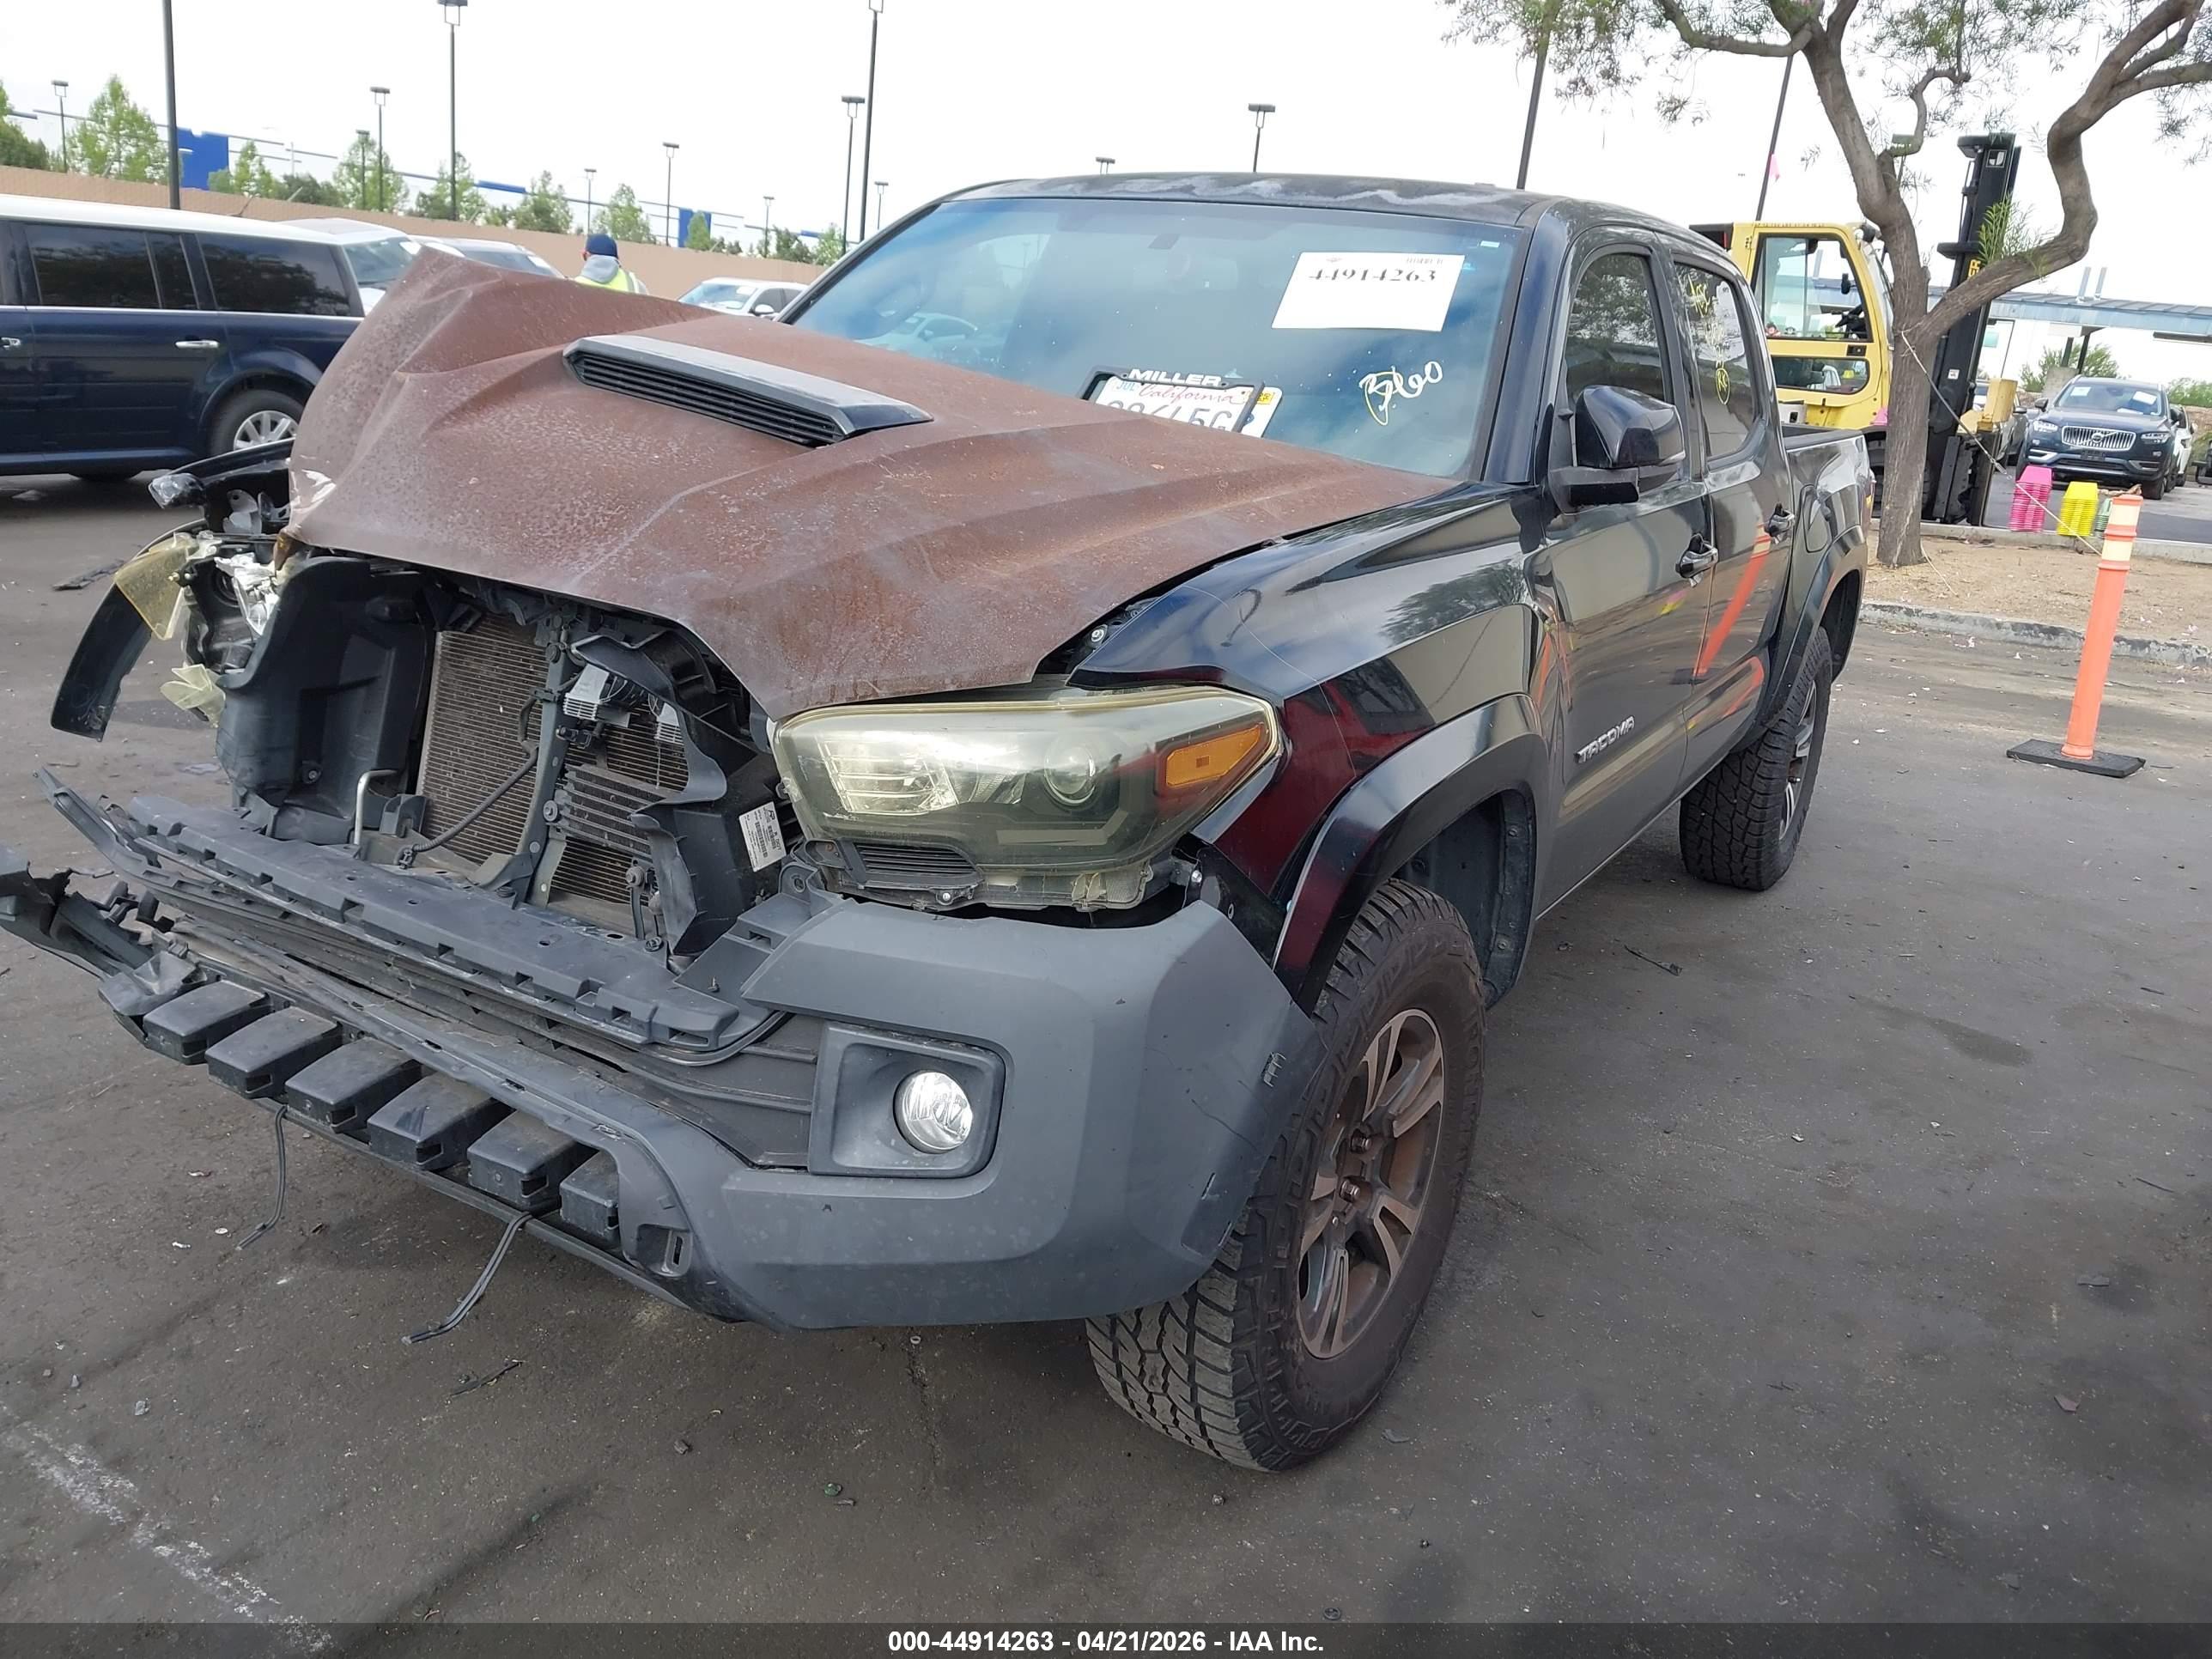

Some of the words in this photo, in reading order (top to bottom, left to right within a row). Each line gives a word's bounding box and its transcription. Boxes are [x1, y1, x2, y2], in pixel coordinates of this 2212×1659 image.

[1308, 268, 1437, 282] 44914263
[1127, 368, 1222, 387] MILLER
[1139, 384, 1241, 404] California
[1576, 714, 1635, 763] TACOMA
